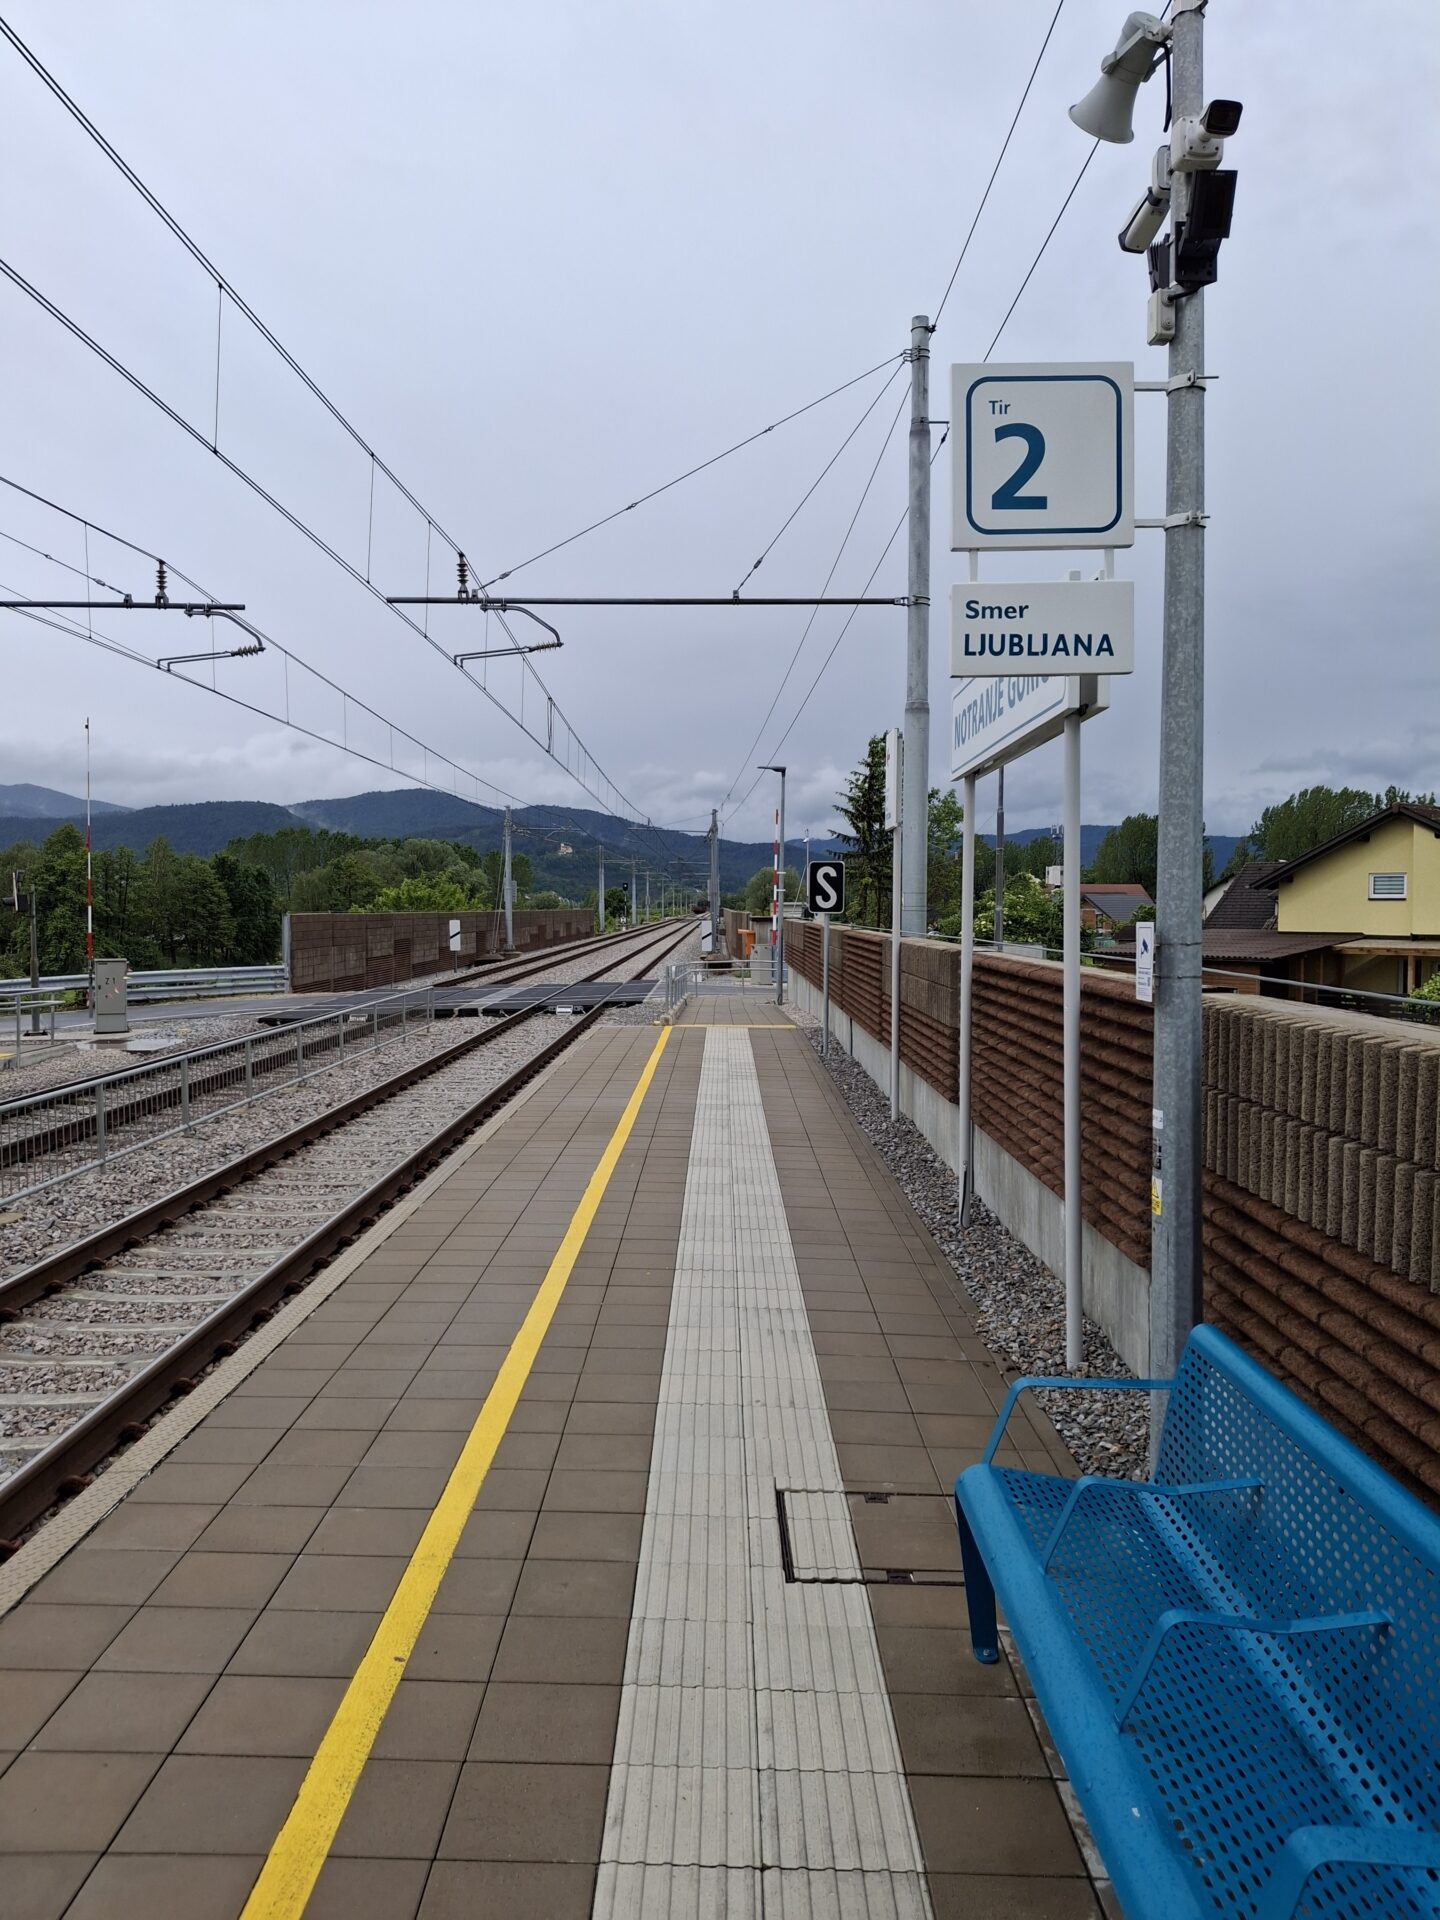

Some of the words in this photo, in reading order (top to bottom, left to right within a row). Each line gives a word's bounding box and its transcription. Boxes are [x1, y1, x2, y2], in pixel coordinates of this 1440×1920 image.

[988, 399, 1011, 415] Tir
[991, 422, 1048, 510] 2
[965, 599, 1029, 619] Smer
[964, 633, 1115, 657] LJUBLJANA
[954, 676, 1005, 751] NOTRANJE
[815, 865, 838, 909] S
